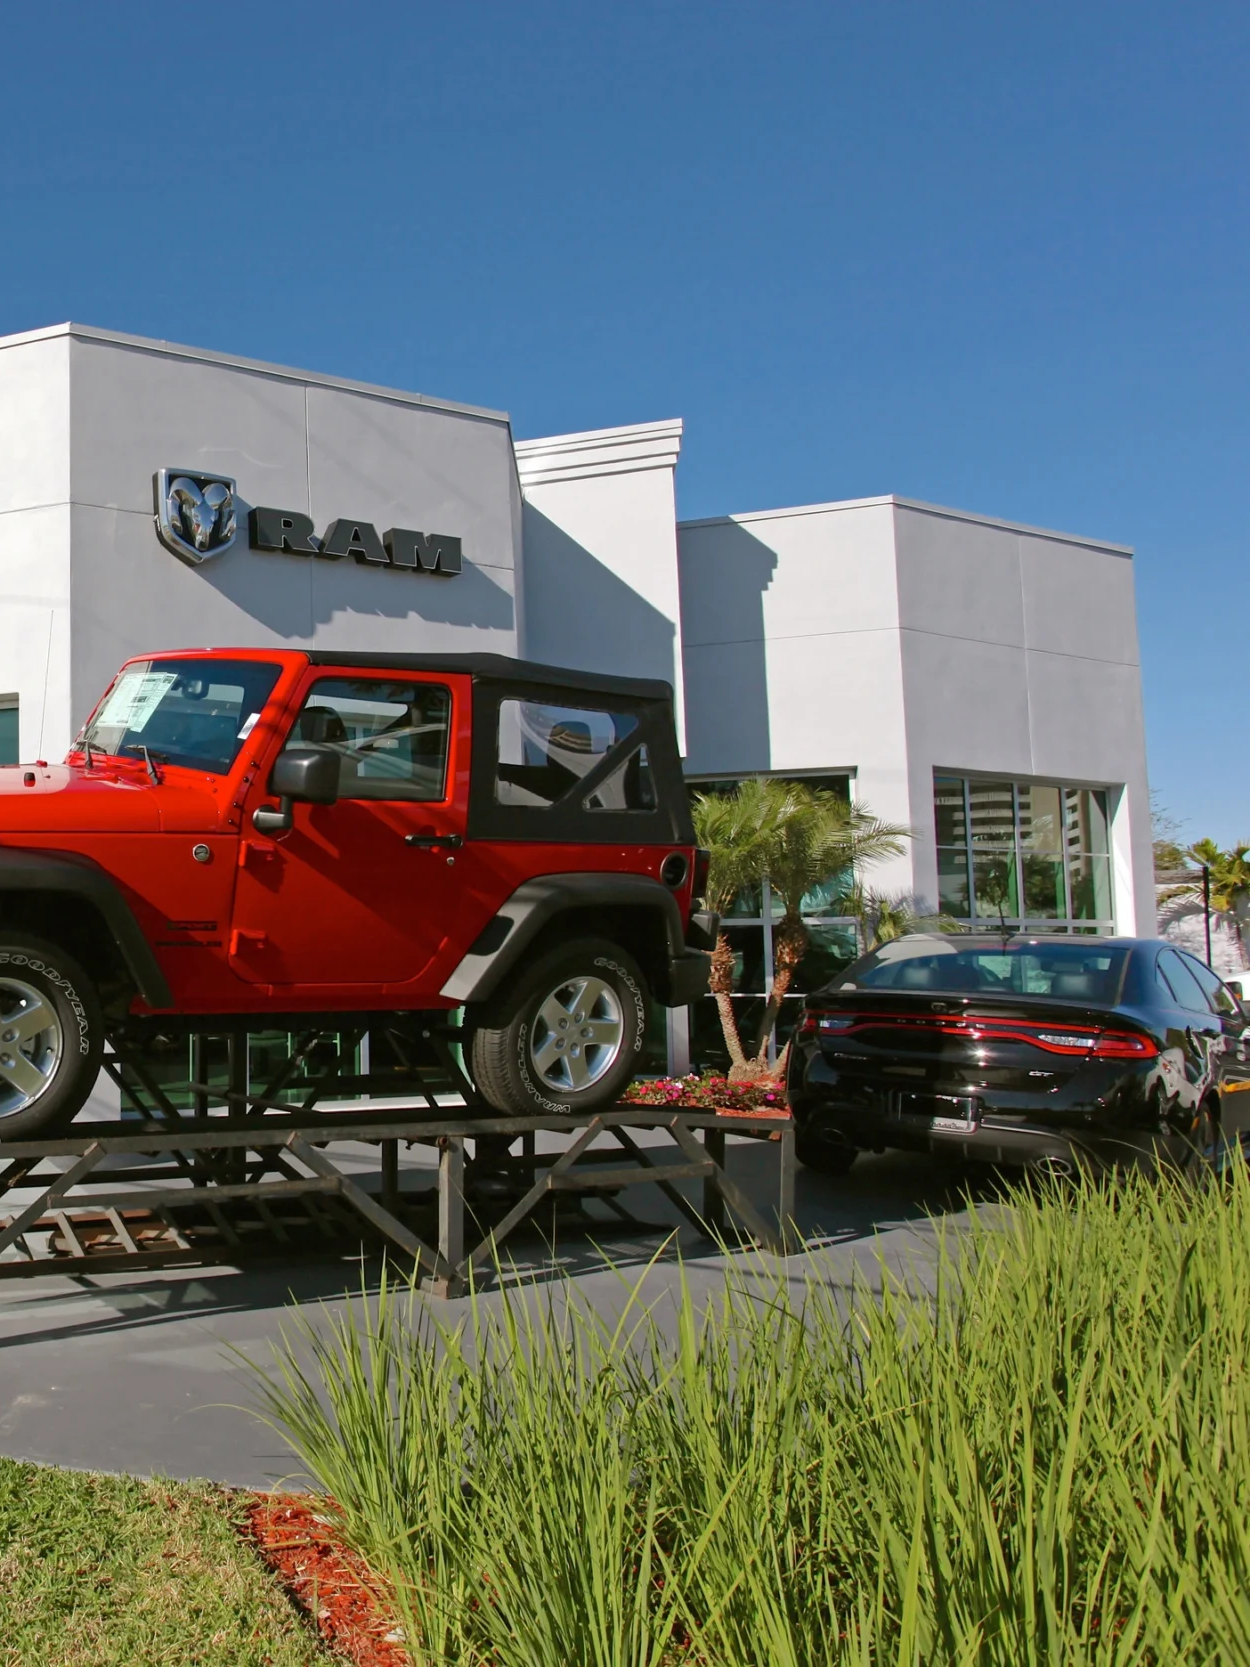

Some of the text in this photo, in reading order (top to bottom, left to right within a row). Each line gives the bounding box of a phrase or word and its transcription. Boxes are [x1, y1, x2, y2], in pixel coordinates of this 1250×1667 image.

[248, 506, 463, 577] RAM
[593, 956, 646, 1052] GOODYEAR
[517, 1022, 571, 1113] WRANGLER
